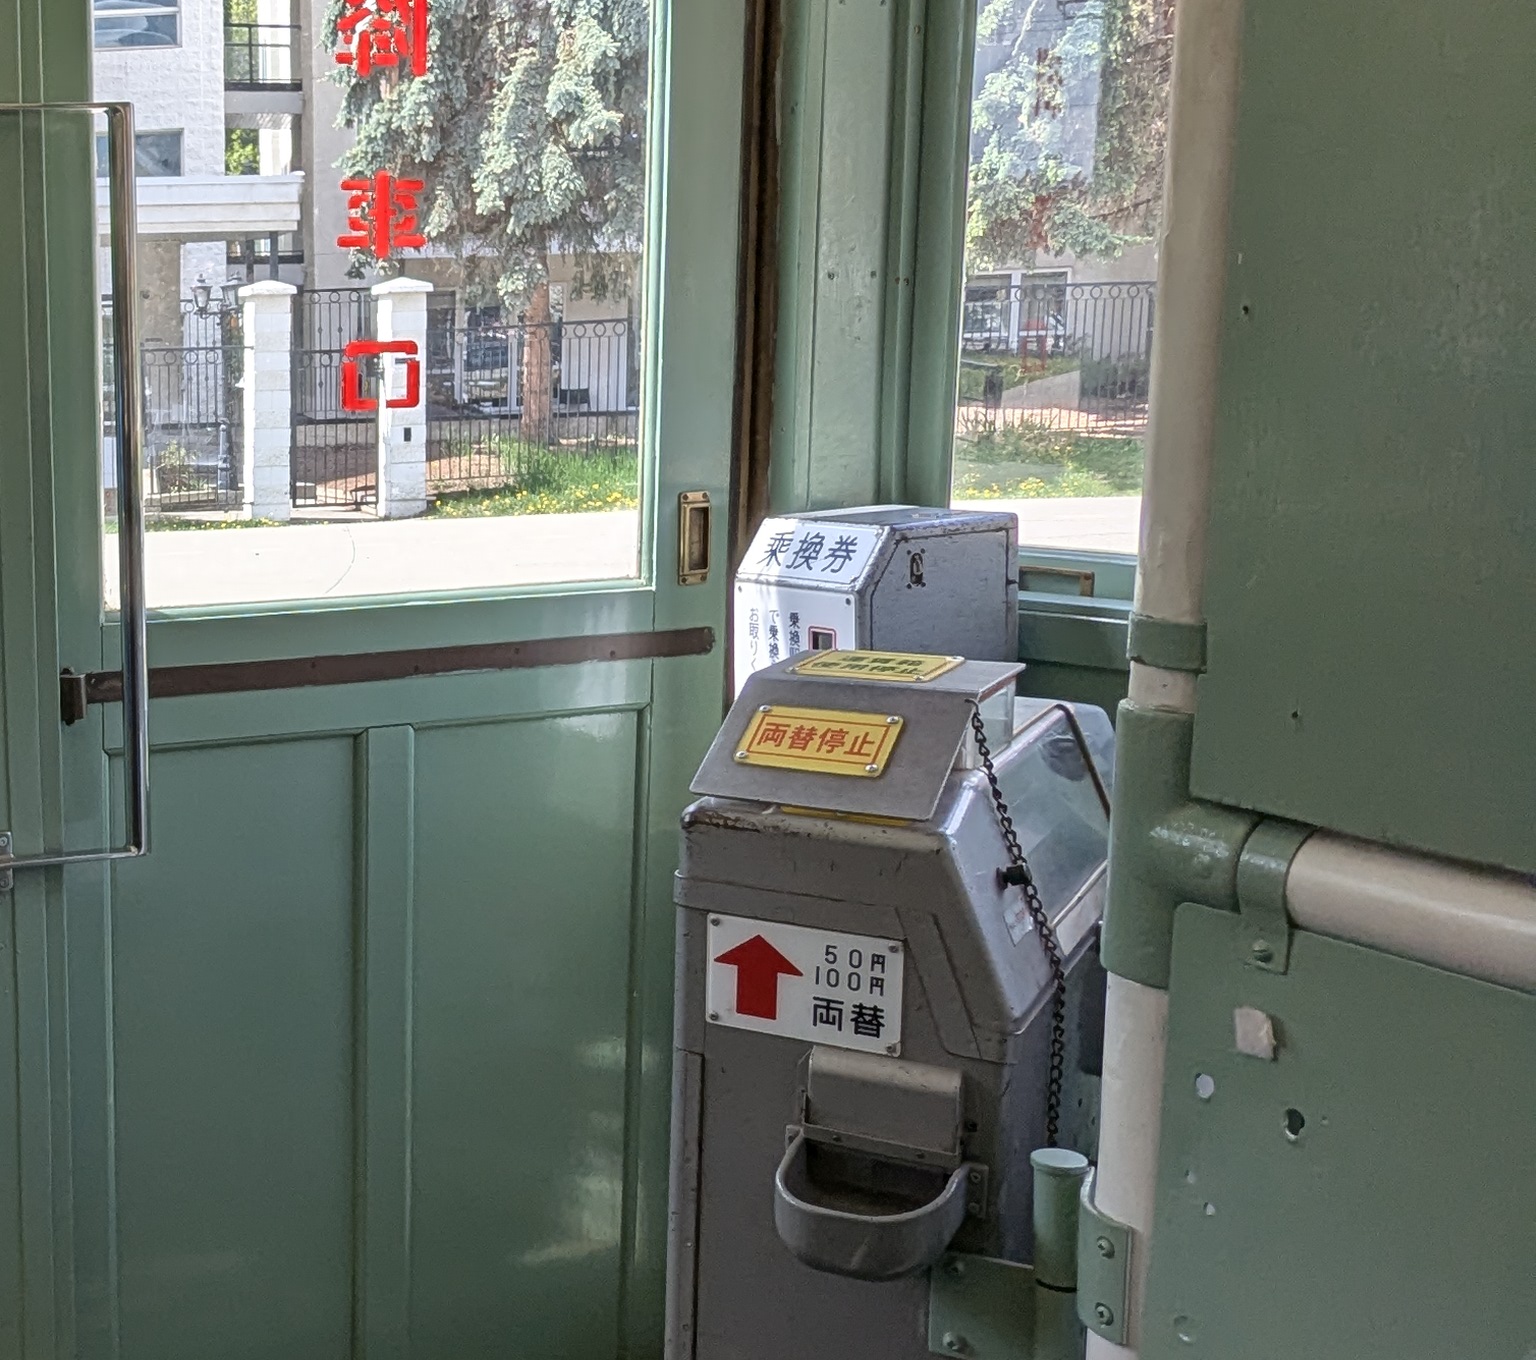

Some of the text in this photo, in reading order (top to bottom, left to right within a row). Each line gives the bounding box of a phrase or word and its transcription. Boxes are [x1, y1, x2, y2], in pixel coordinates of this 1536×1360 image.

[756, 531, 860, 574] 乗換券
[756, 722, 876, 758] 両替停止
[824, 944, 886, 974] 50円
[814, 965, 886, 997] 100円
[812, 995, 886, 1039] 両替
